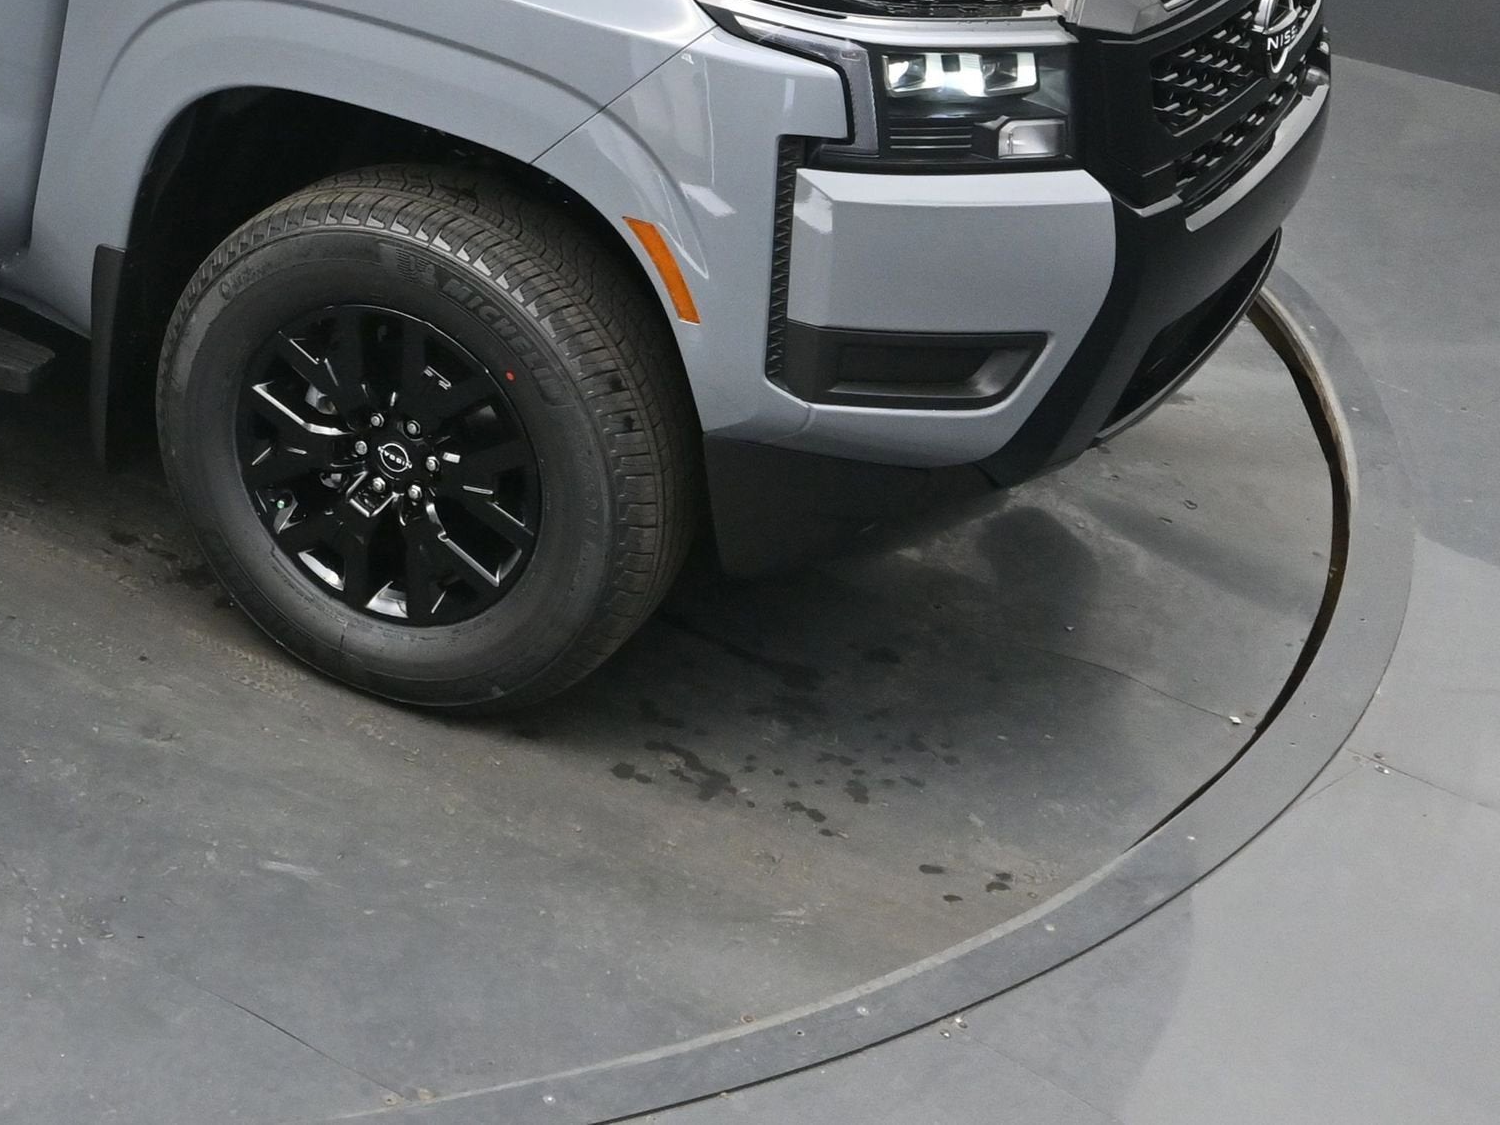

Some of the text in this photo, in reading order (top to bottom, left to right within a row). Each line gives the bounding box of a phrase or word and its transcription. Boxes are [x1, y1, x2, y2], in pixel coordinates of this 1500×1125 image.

[1267, 24, 1299, 51] NISS
[440, 277, 574, 403] MICHELIN
[377, 445, 413, 469] NISSAN
